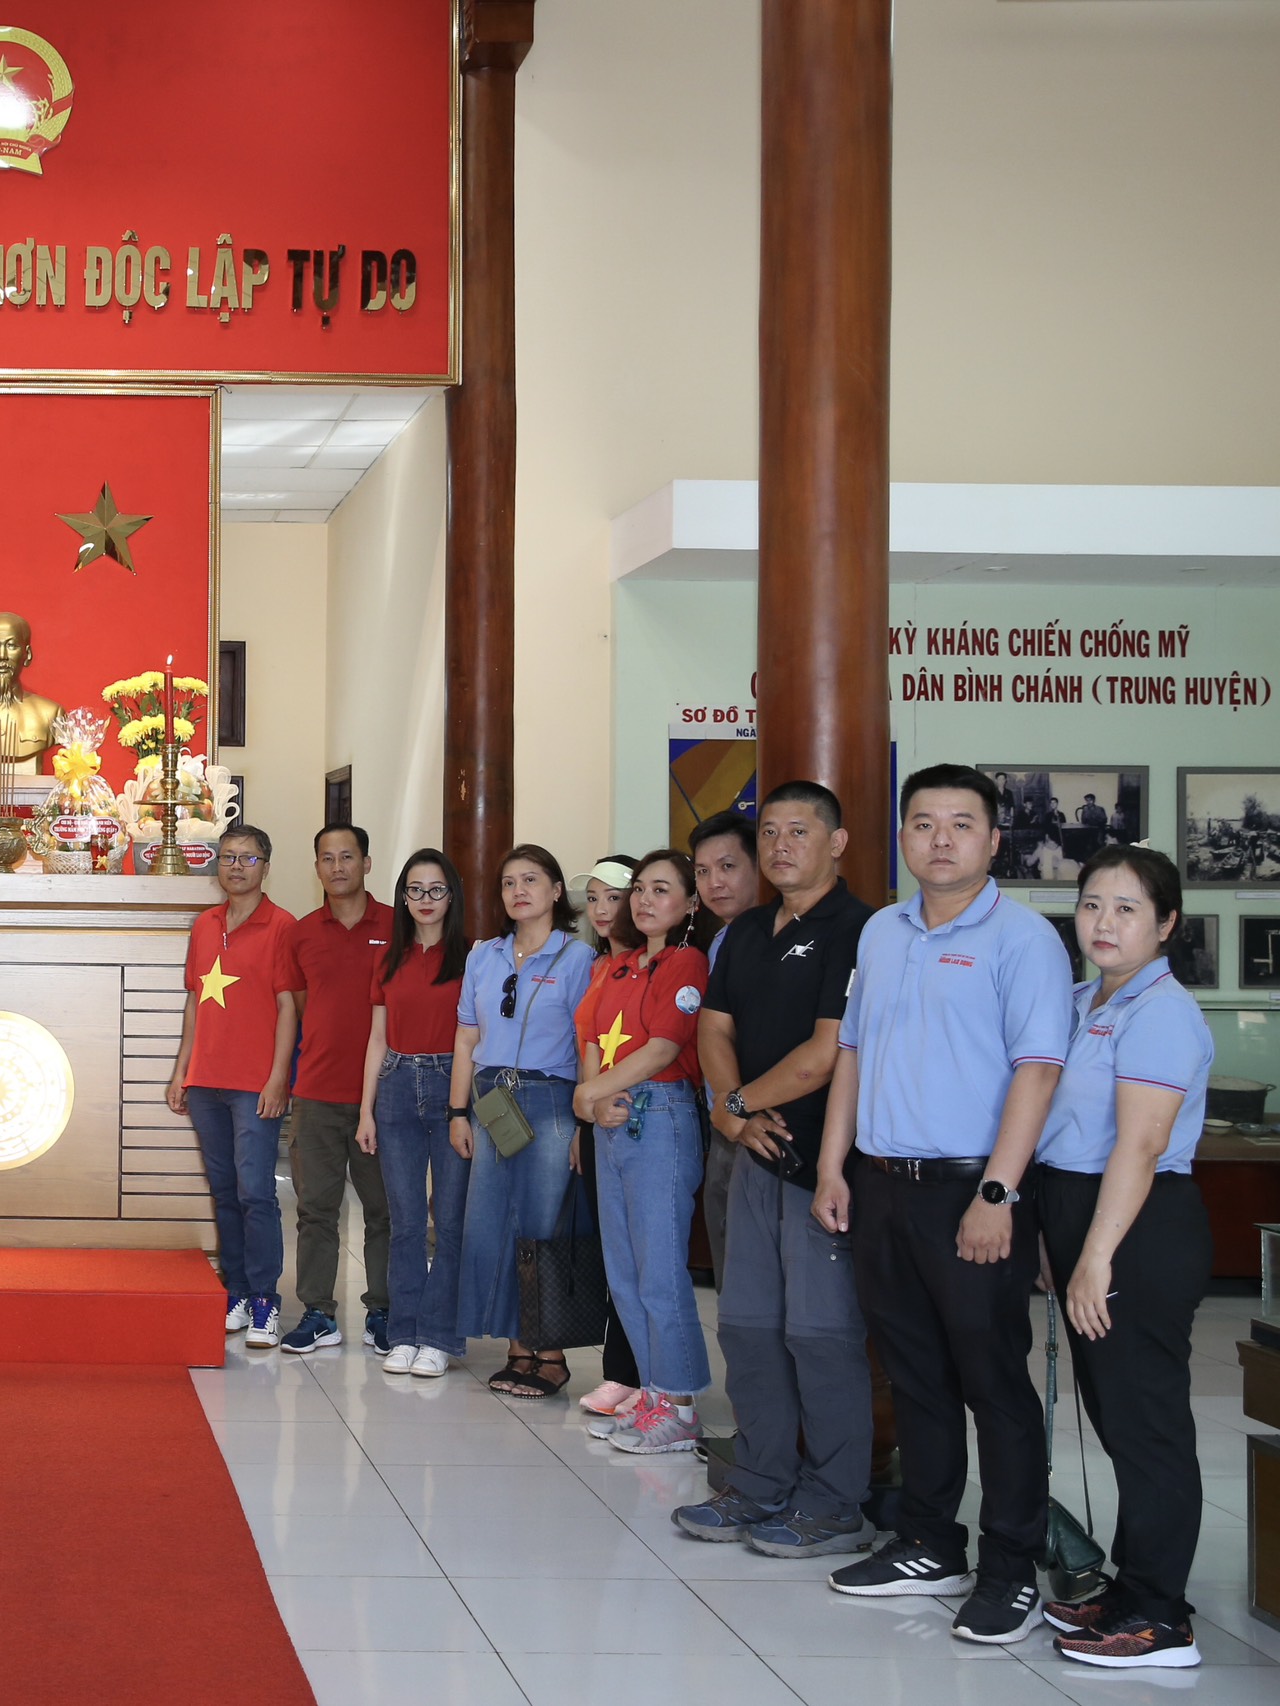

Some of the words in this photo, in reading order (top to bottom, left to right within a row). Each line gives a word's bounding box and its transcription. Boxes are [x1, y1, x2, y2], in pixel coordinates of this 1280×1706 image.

[84, 229, 171, 322] ĐỘC
[186, 233, 270, 323] LẬP
[287, 244, 346, 326] TỰ
[361, 248, 417, 311] DO
[889, 620, 917, 655] KỲ
[927, 620, 999, 656] KHÁNG
[1008, 619, 1071, 657] CHIẾN
[1080, 619, 1150, 658] CHỐNG
[1158, 624, 1190, 658] MỸ
[902, 666, 944, 701] DÂN
[953, 666, 1002, 702] BÌNH
[1011, 668, 1083, 703] CHÁNH
[1092, 674, 1176, 705] (TRUNG
[1185, 670, 1272, 712] HUYỆN)
[681, 706, 707, 723] SƠ
[712, 705, 739, 723] ĐỒ
[736, 726, 757, 737] NGÀ
